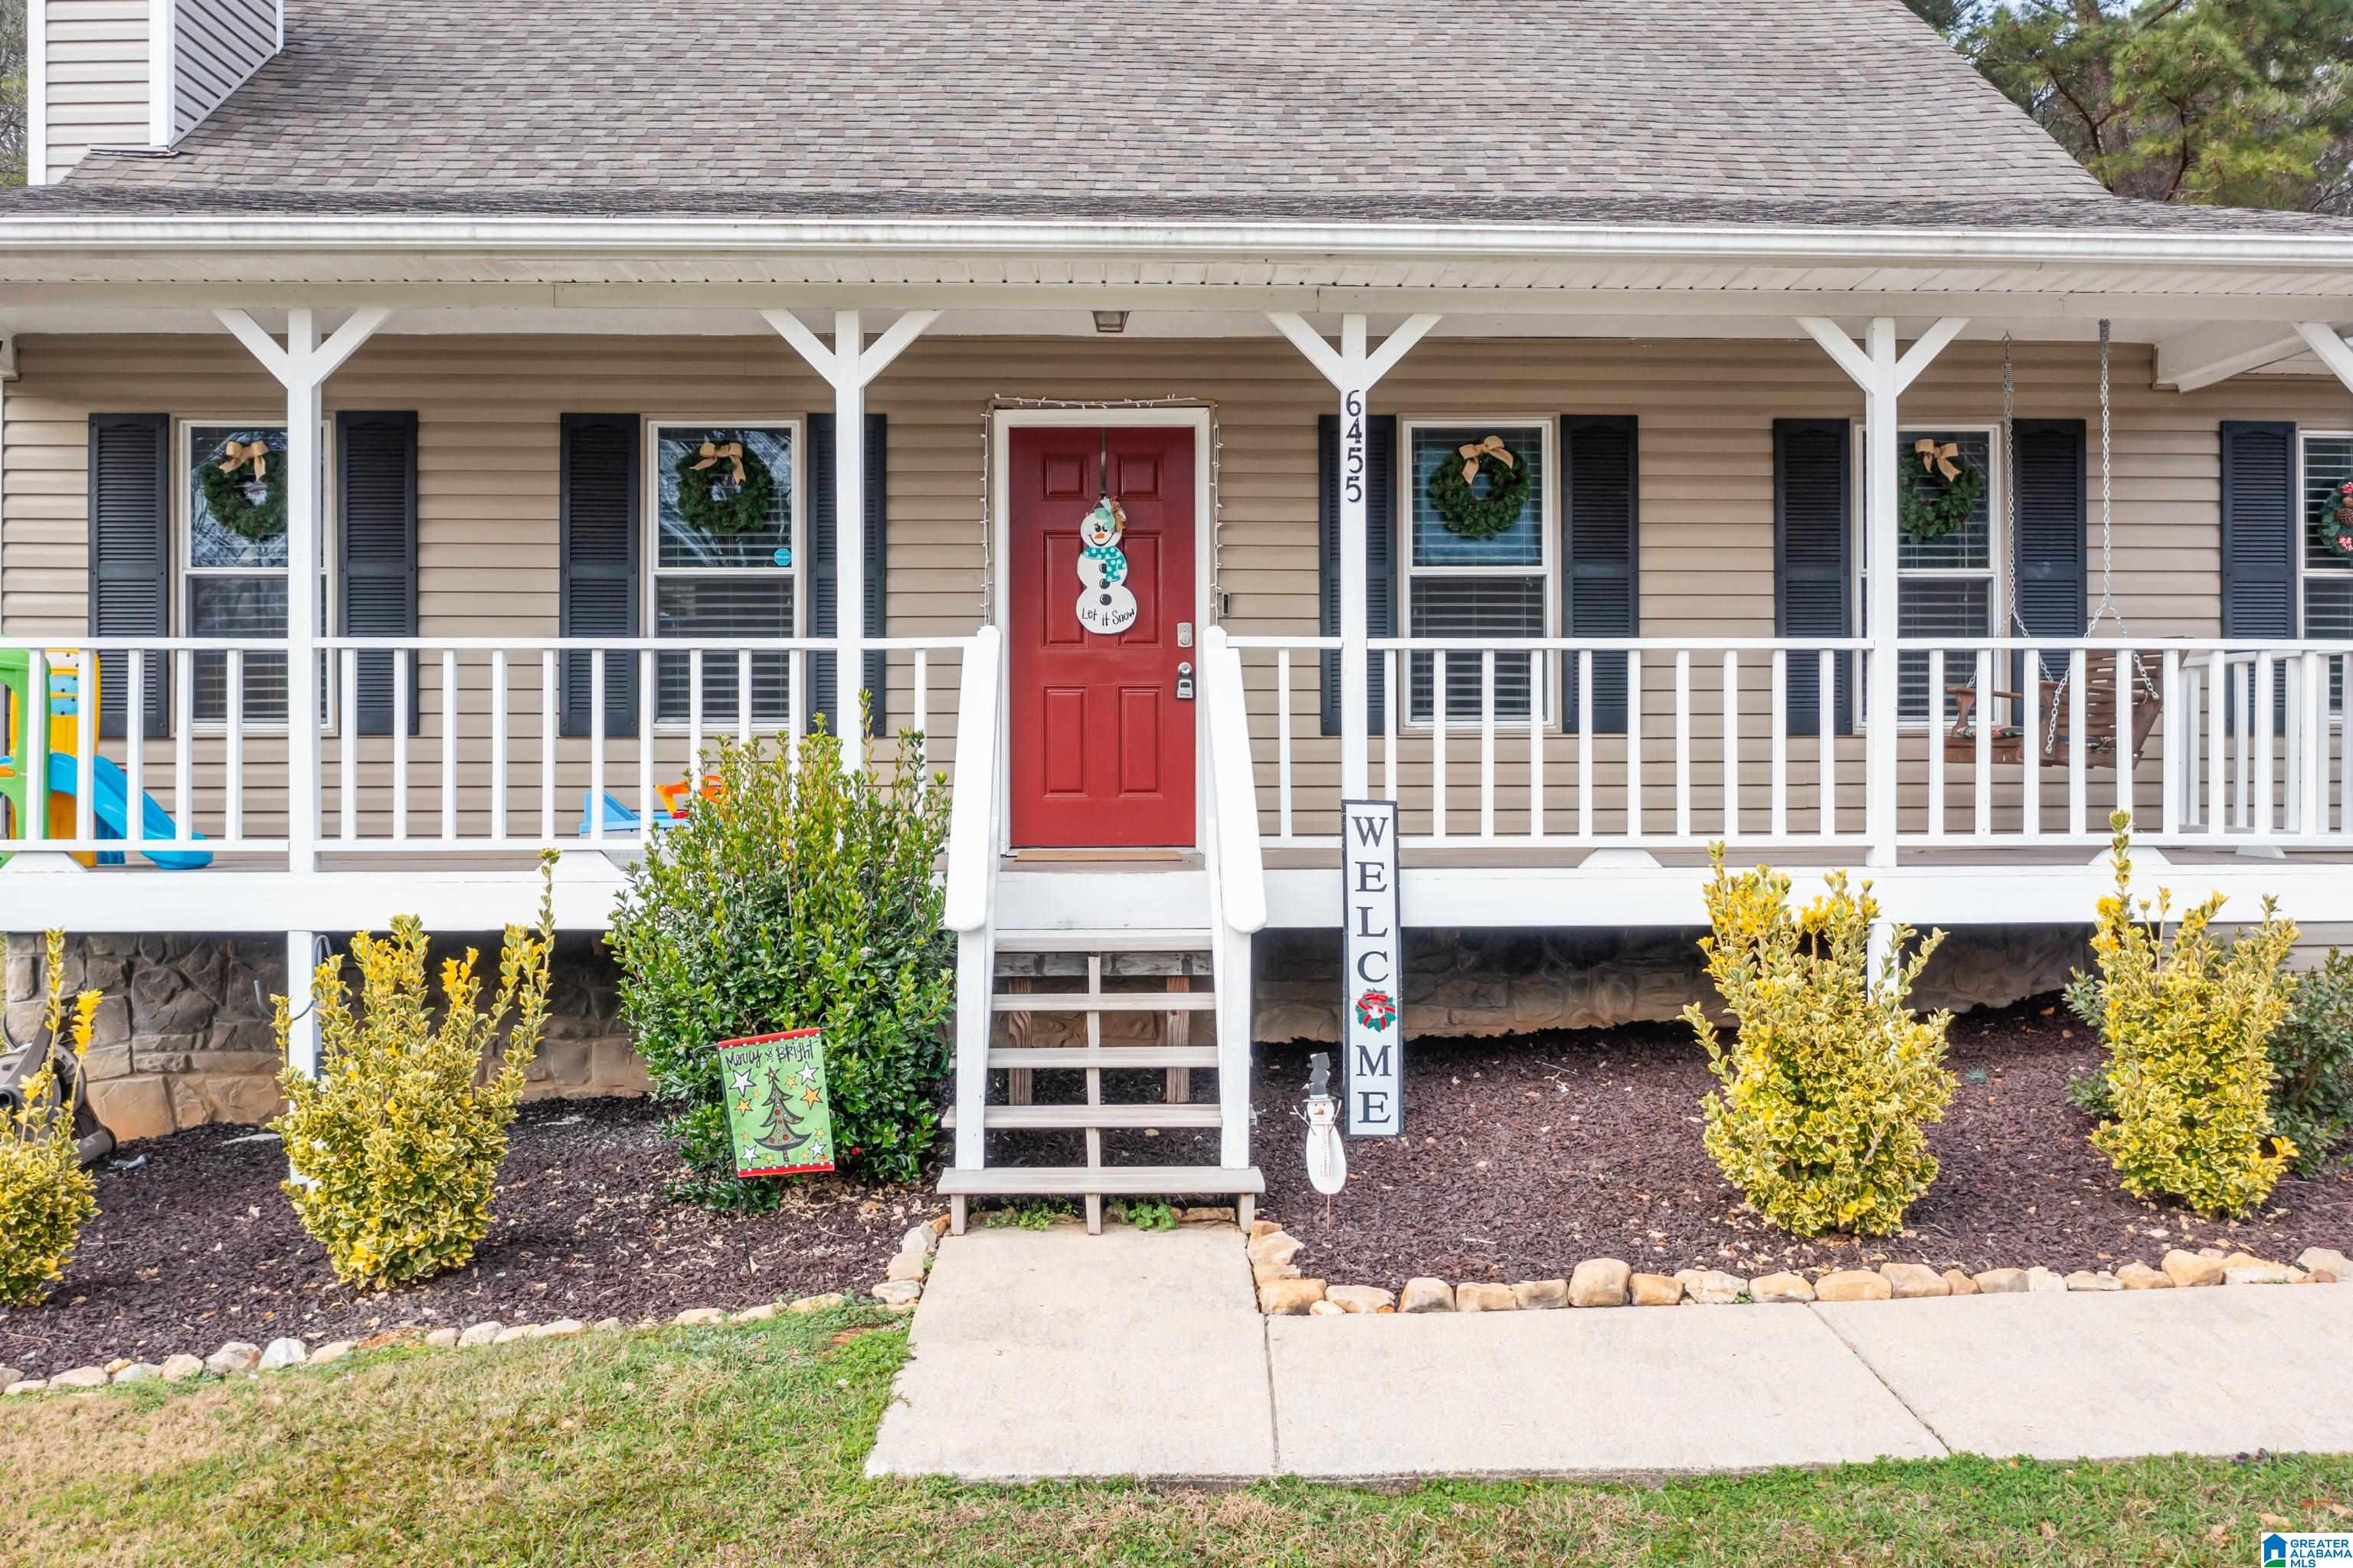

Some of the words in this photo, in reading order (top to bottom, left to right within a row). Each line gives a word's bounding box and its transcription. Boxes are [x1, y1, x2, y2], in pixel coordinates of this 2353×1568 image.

[1346, 389, 1363, 503] 6455
[1082, 607, 1097, 621] Let
[1102, 612, 1109, 626] it
[1112, 608, 1134, 625] Snow
[1351, 816, 1392, 1124] WELCME
